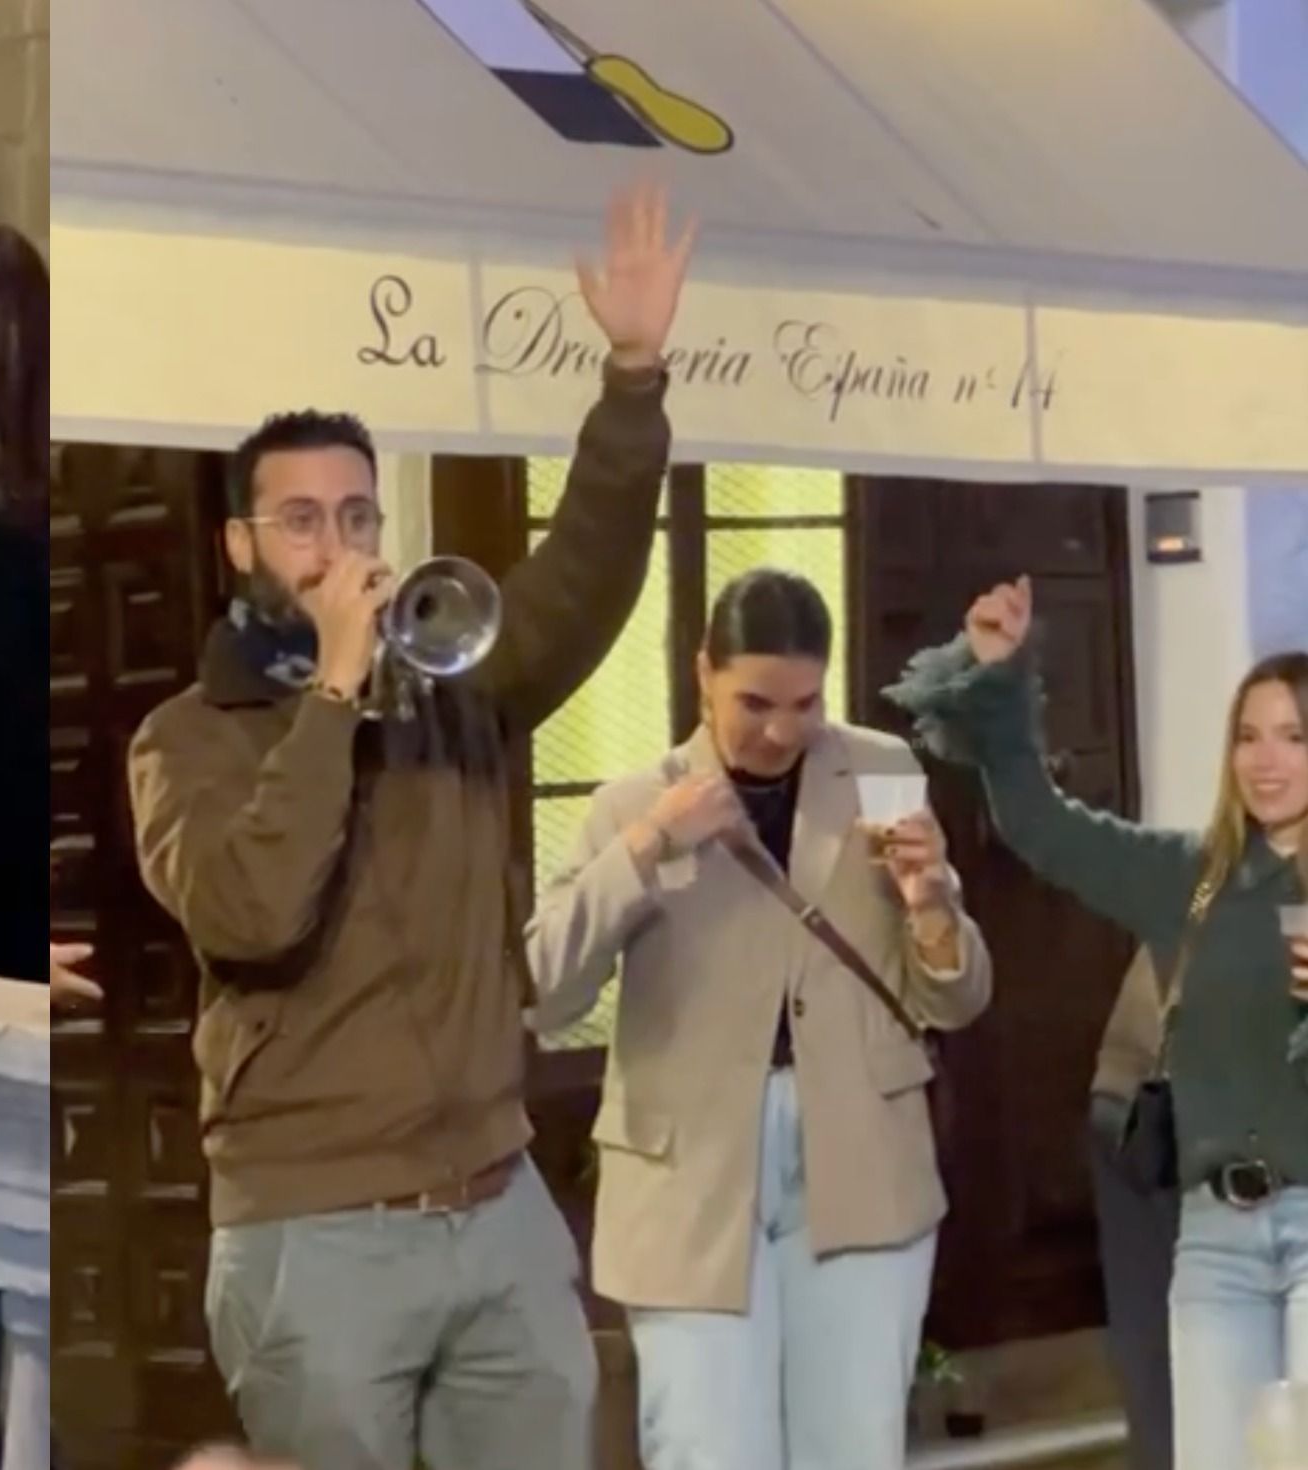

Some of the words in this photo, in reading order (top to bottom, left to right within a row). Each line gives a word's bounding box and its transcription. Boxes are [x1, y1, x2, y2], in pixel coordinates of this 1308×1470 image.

[357, 274, 445, 367] La
[474, 285, 750, 386] Droeria
[772, 319, 929, 422] España
[1010, 346, 1069, 410] 14
